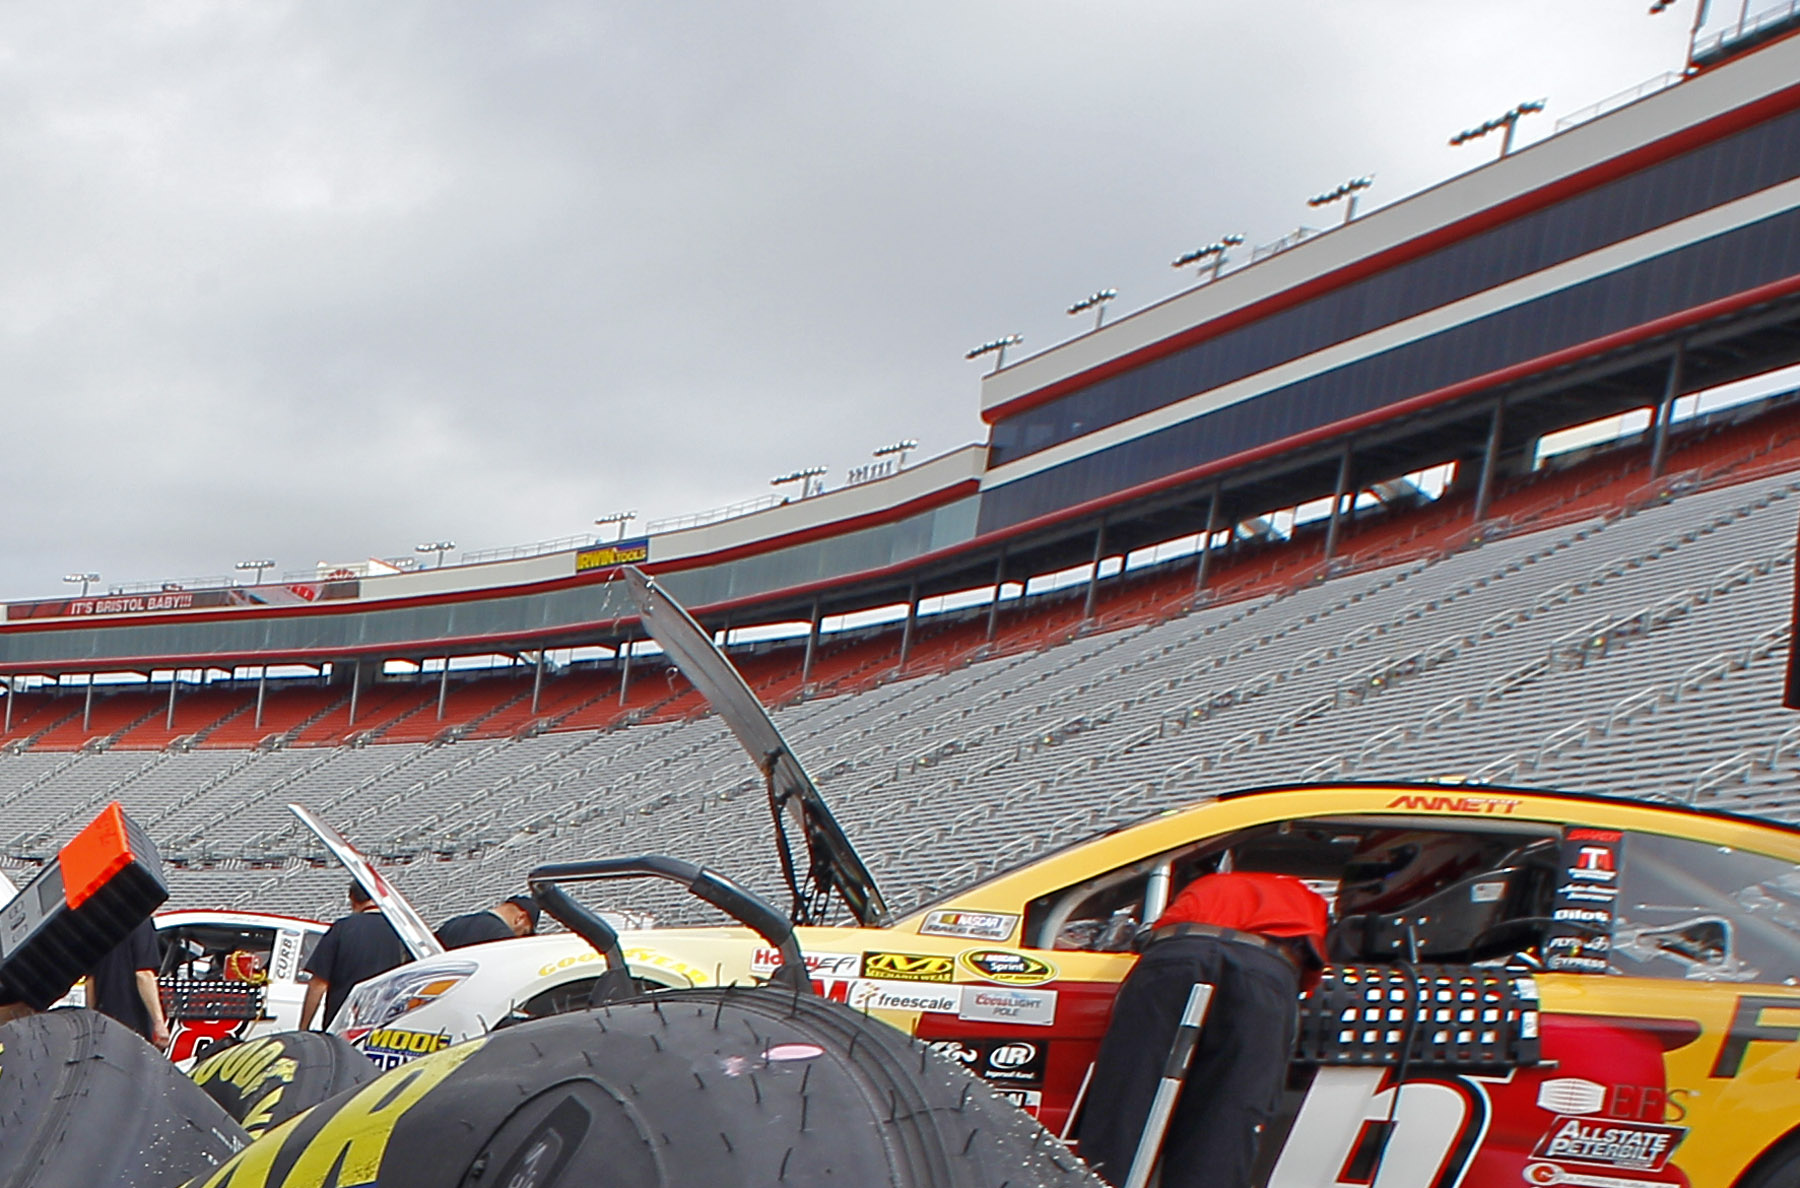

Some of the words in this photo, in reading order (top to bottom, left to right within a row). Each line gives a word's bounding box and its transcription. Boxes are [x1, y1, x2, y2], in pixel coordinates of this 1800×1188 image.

[71, 600, 93, 615] IT'S
[95, 596, 145, 614] BRISTOL
[1386, 795, 1523, 814] ANNETT
[957, 913, 1001, 928] NASCAR
[276, 937, 293, 980] CURB
[990, 961, 1025, 973] Sprint
[877, 992, 956, 1011] freescale
[992, 1007, 1018, 1017] POLE
[997, 1047, 1027, 1065] IR
[1609, 1084, 1688, 1122] EFS
[1556, 1120, 1672, 1149] ALLSTATE
[1546, 1138, 1664, 1162] PETERBILT
